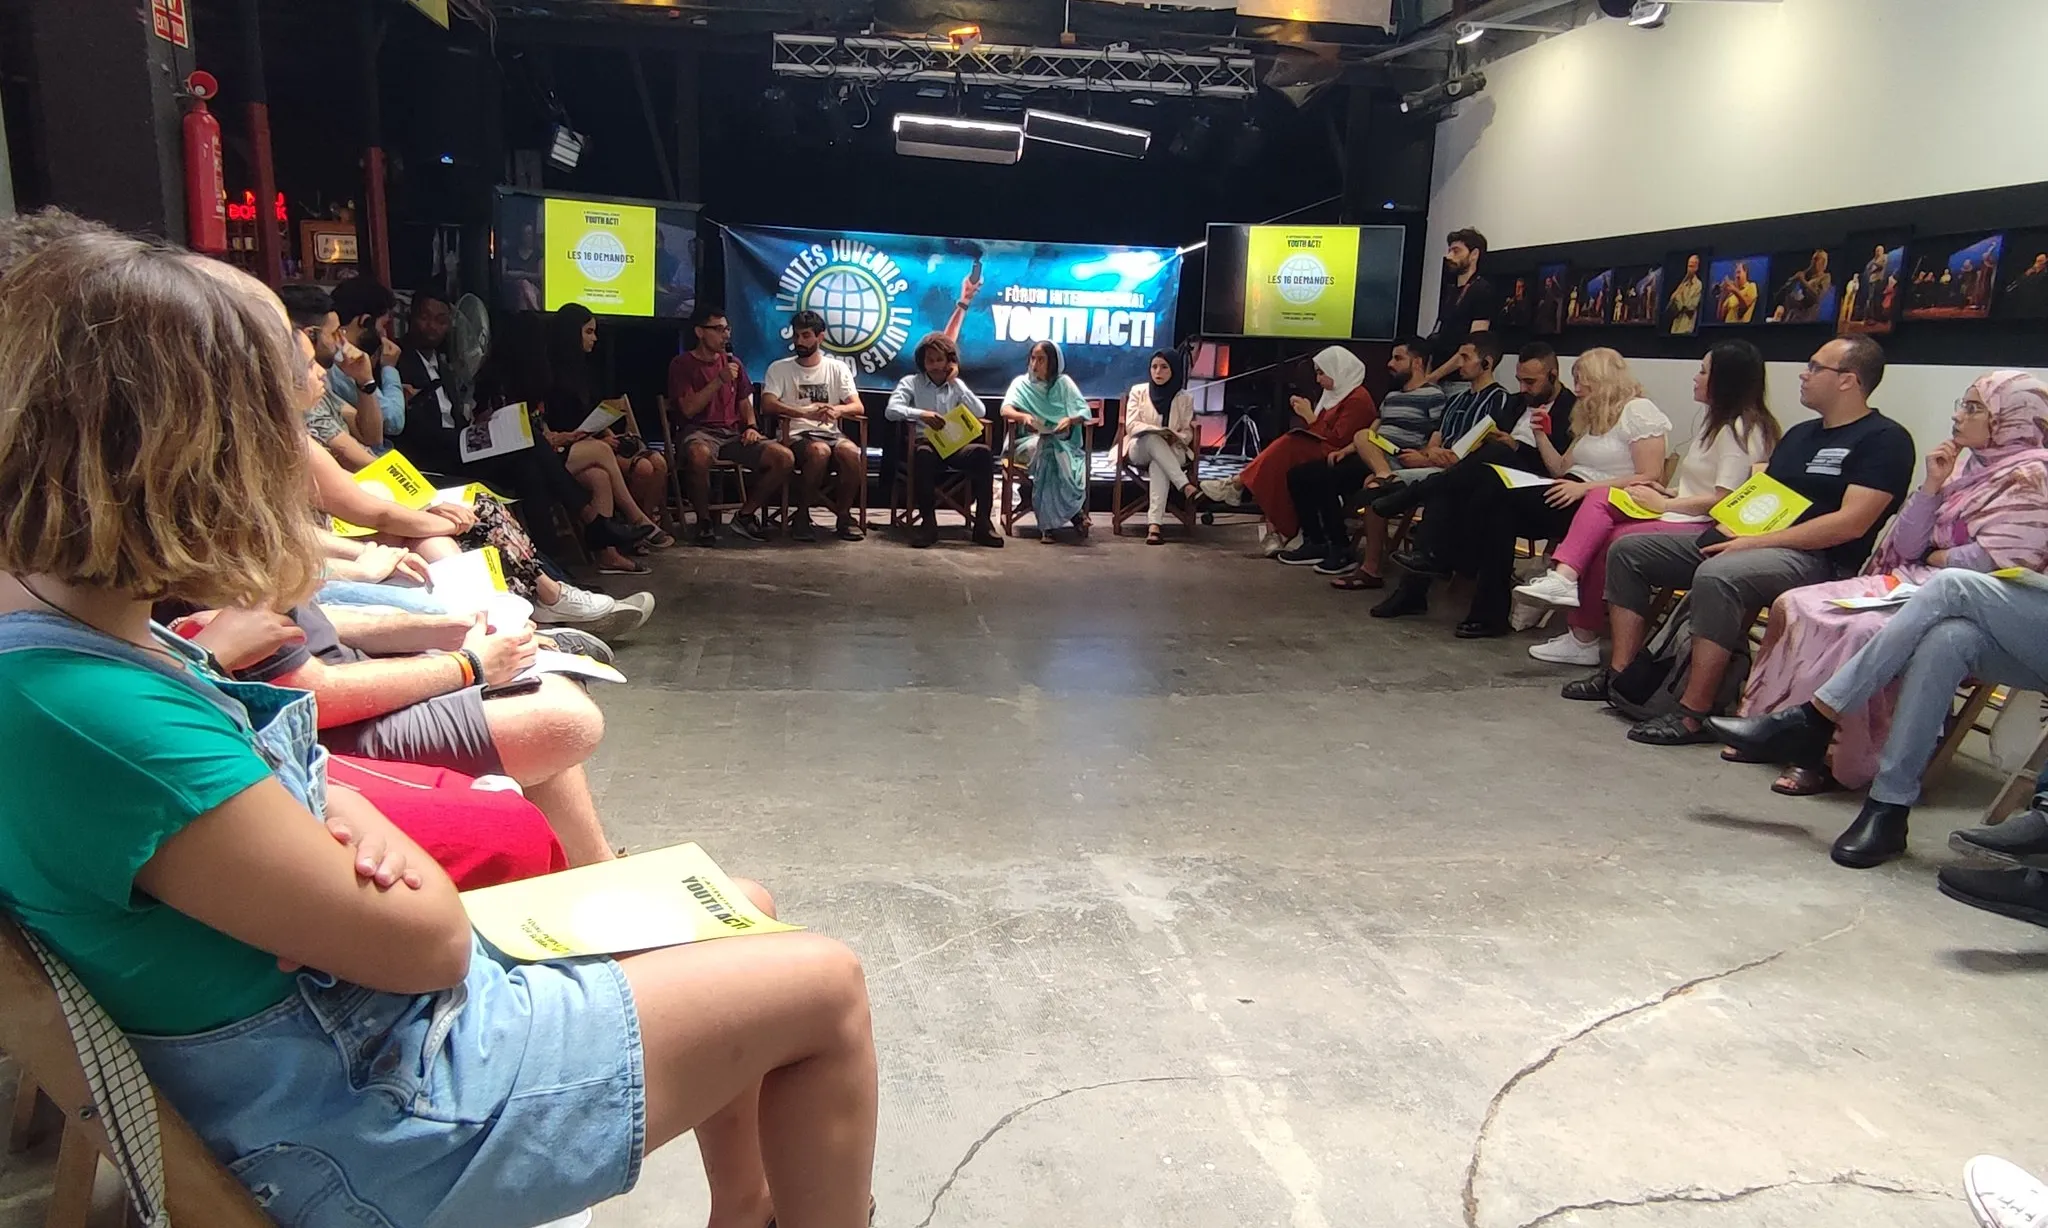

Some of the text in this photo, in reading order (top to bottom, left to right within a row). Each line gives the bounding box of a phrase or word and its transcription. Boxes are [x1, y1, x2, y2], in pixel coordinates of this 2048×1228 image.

[585, 215, 619, 226] YOUTH ACT!
[1287, 239, 1321, 248] YOUTH ACT!
[567, 250, 635, 263] LES 16 DEMANDES
[1267, 275, 1335, 285] LES 16 DEMANDES
[1049, 289, 1145, 308] INTERAL
[776, 244, 828, 311] LLUITES
[860, 307, 912, 374] LLUITES
[991, 304, 1156, 348] YOUTH ACT!
[386, 464, 407, 484] YOUTH
[681, 876, 724, 912] YOUTH
